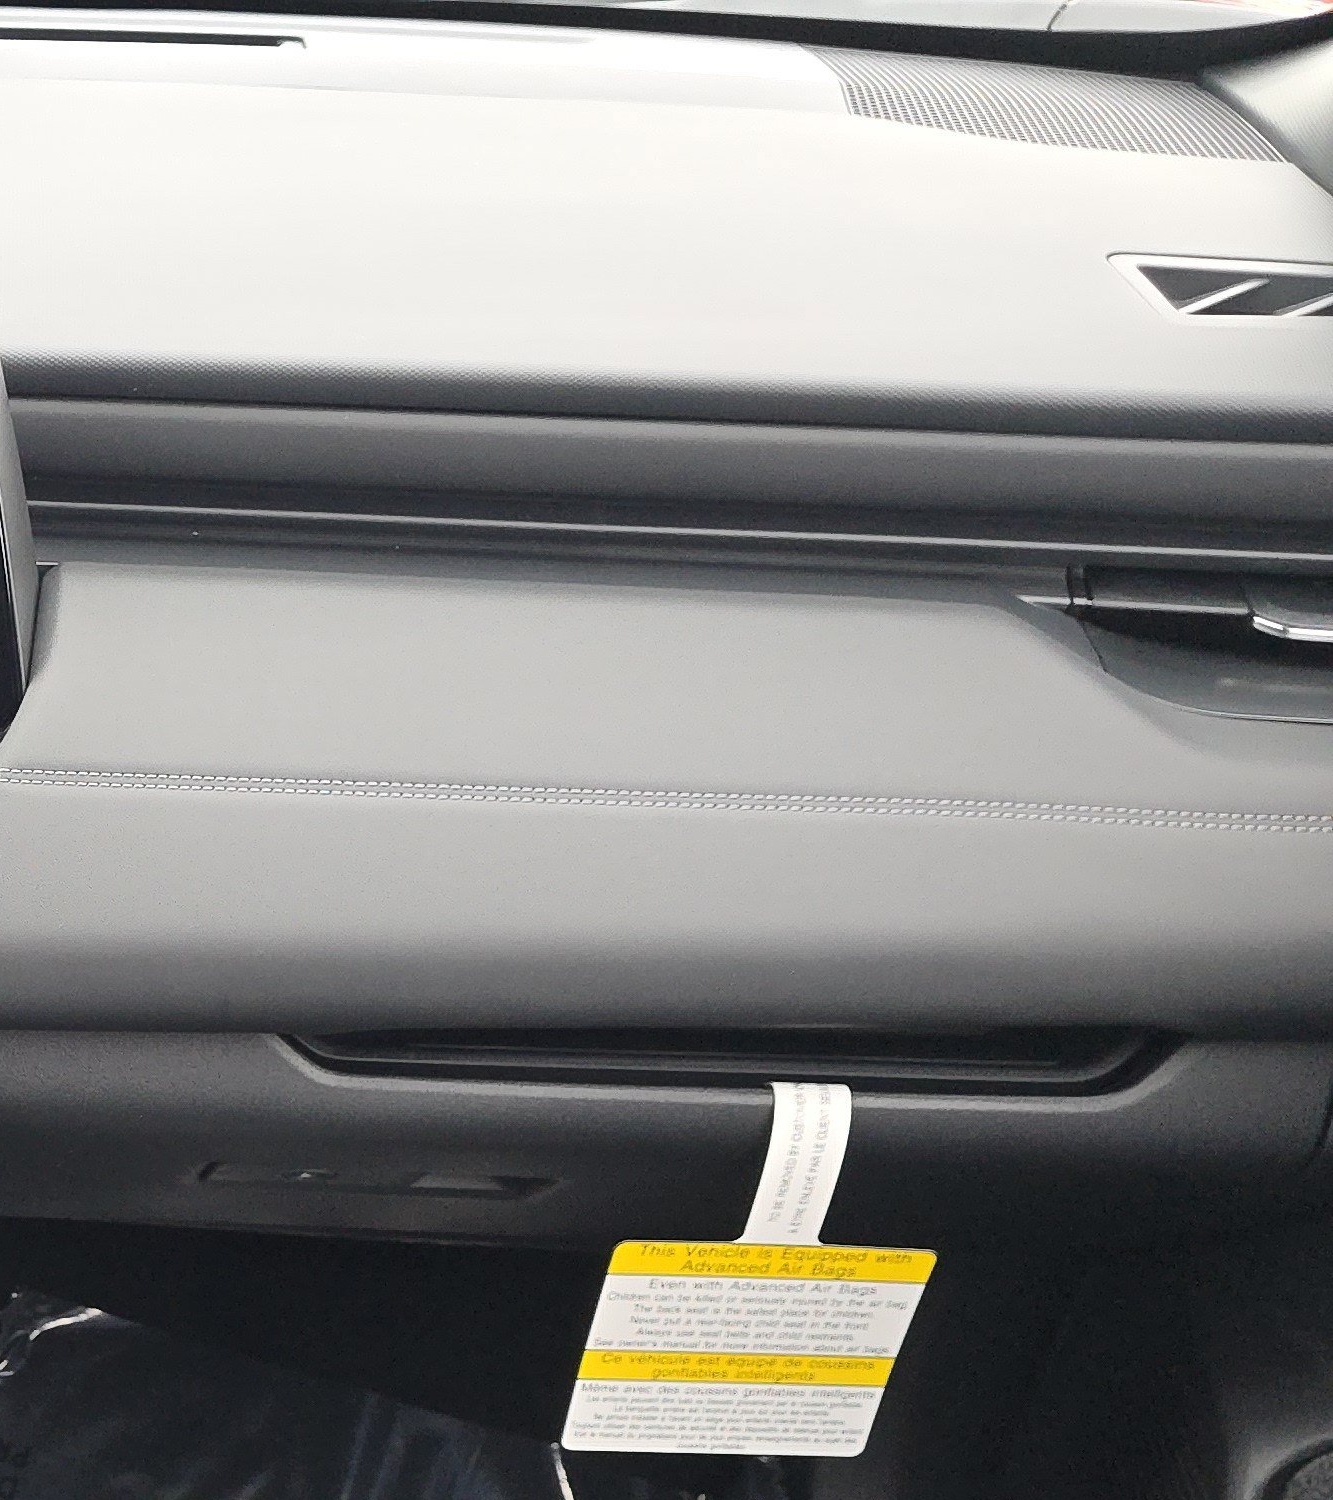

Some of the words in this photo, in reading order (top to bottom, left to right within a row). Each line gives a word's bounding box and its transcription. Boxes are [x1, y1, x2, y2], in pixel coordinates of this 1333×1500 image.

[640, 1244, 676, 1257] This
[685, 1245, 750, 1259] Vehicle
[757, 1247, 773, 1259] is
[782, 1248, 869, 1263] Equipped
[874, 1253, 913, 1263] with
[679, 1260, 771, 1273] Advanced
[777, 1263, 803, 1274] Air
[811, 1264, 857, 1278] Bags
[648, 1279, 687, 1290] Even
[692, 1280, 724, 1290] with
[728, 1280, 805, 1293] Advanced
[811, 1283, 832, 1293] Air
[837, 1284, 878, 1296] Bags
[601, 1353, 622, 1364] Ce
[697, 1355, 722, 1366] est
[782, 1358, 803, 1368] de
[807, 1360, 876, 1370] coussins
